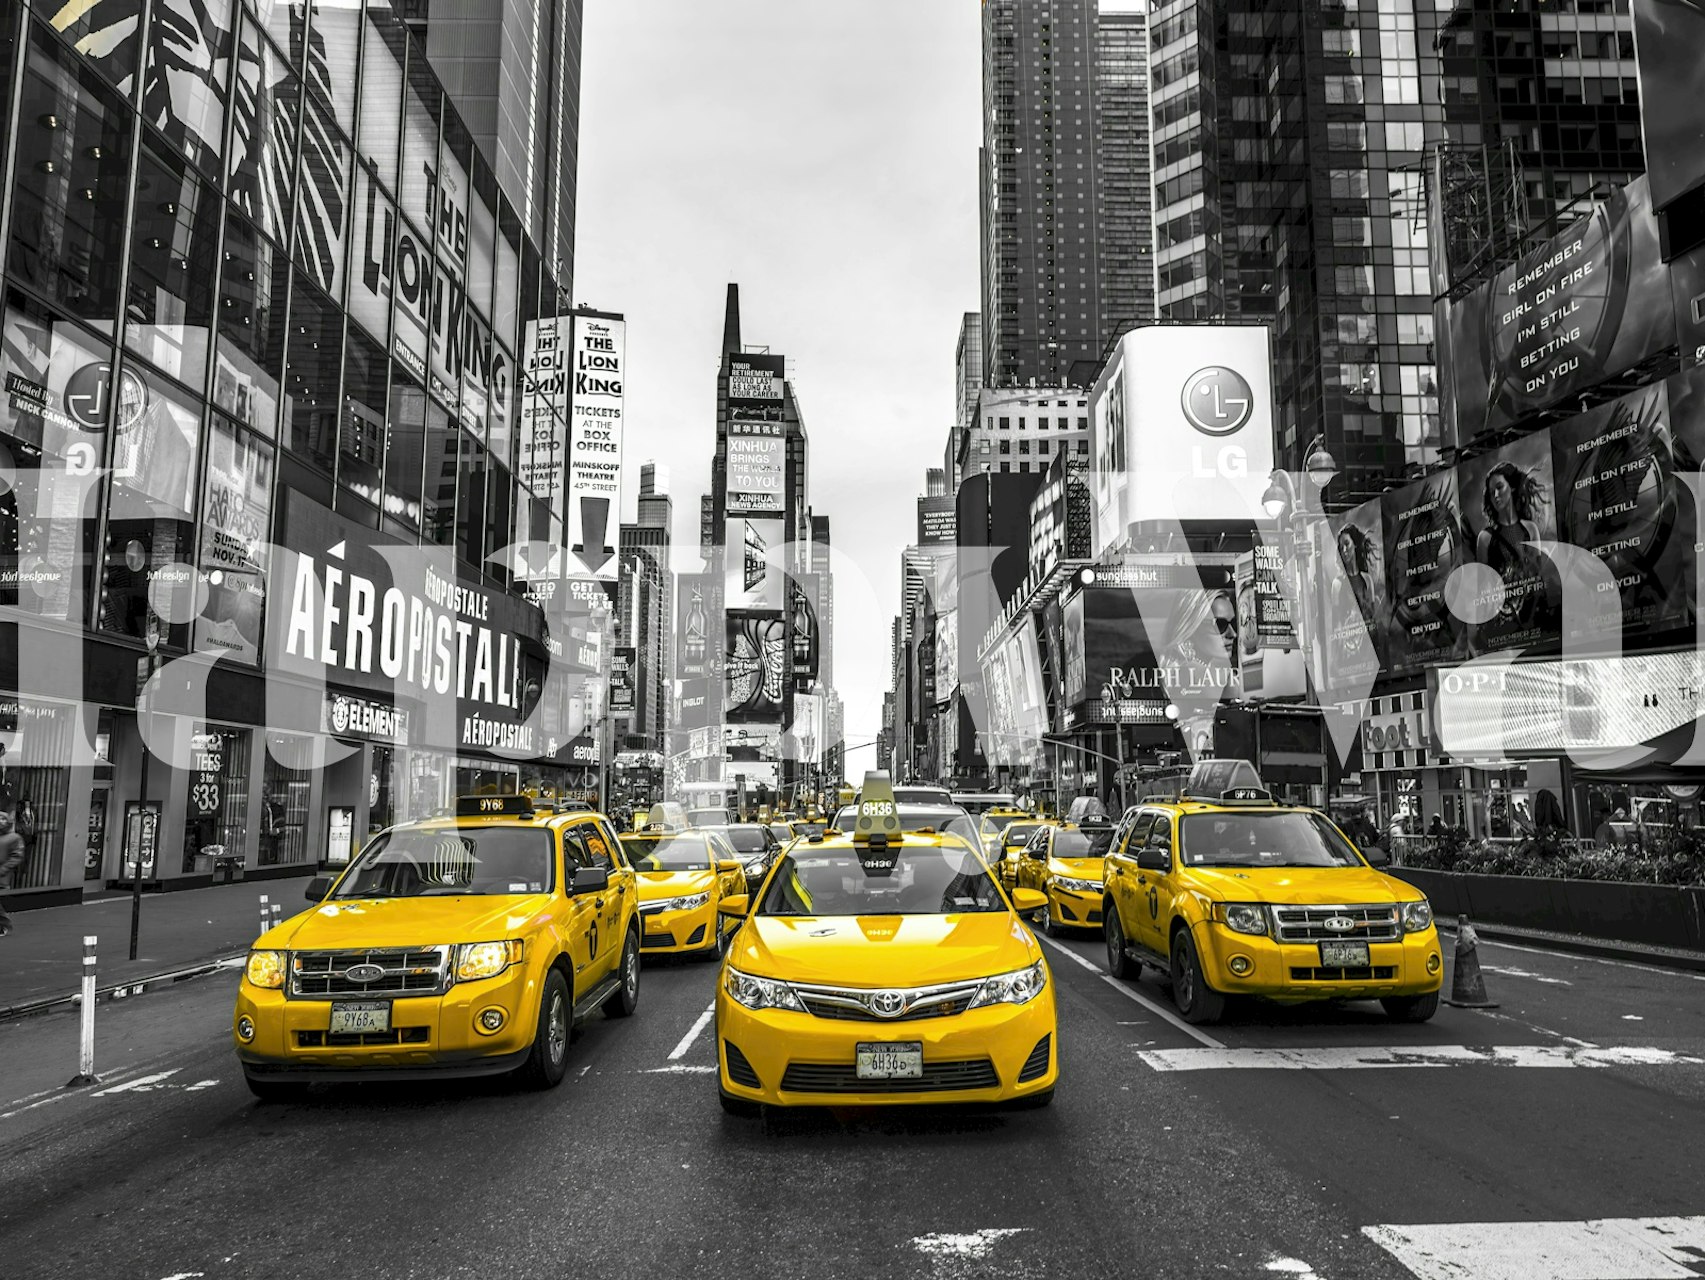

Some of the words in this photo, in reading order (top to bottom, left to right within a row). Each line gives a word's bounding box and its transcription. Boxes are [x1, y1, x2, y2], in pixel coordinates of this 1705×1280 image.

[423, 160, 465, 263] THE
[363, 156, 442, 338] LION
[1508, 240, 1582, 296] REMEMBER
[1502, 302, 1532, 325] GIRL
[1536, 285, 1556, 305] ON
[1561, 261, 1593, 290] FIRE
[1517, 325, 1536, 343] I'M
[1541, 301, 1580, 328] STILL
[446, 266, 505, 410] KING
[584, 336, 613, 350] THE
[1520, 327, 1581, 368] BETTING
[395, 338, 425, 376] ENTRANCE
[579, 350, 618, 371] LION
[731, 362, 751, 370] YOUR
[732, 377, 755, 385] COULD
[1526, 376, 1545, 392] ON
[1549, 356, 1579, 379] YOU
[12, 378, 42, 399] Hosted
[575, 372, 622, 395] KING
[16, 399, 40, 416] NICK
[41, 410, 80, 431] CANNON
[462, 405, 476, 427] STREET
[574, 405, 620, 419] TICKETS
[582, 420, 594, 428] AT
[596, 420, 612, 429] THE
[732, 424, 781, 435] 新华通讯社
[584, 430, 611, 440] BOX
[1576, 423, 1638, 454] REMEMBER
[576, 441, 617, 453] OFFICE
[730, 440, 777, 452] XINHUA
[572, 461, 620, 471] MINSKOFF
[730, 454, 770, 464] BRINGS
[1191, 444, 1248, 479] LG
[577, 471, 614, 481] THEATRE
[732, 464, 749, 473] THE
[1575, 472, 1598, 490] GIRL
[1601, 466, 1618, 481] ON
[1620, 459, 1646, 475] FIRE
[573, 482, 590, 490] 45TH
[592, 484, 618, 492] STREET
[736, 475, 752, 487] TO
[731, 501, 756, 509] NEWS
[738, 493, 774, 504] XINHUA
[1398, 500, 1440, 521] REMEMBER
[1588, 510, 1603, 521] I'M
[1605, 500, 1638, 517] STILL
[1397, 538, 1414, 551] GIRL
[1414, 534, 1425, 546] ON
[1427, 528, 1444, 542] FIRE
[1591, 536, 1641, 557] BETTING
[212, 547, 236, 563] NOV.
[1254, 545, 1279, 558] SOME
[1254, 558, 1284, 570] WALLS
[1406, 567, 1418, 577] I'M
[1418, 561, 1439, 575] STILL
[1095, 570, 1139, 584] sunglass
[1140, 570, 1157, 581] hut
[1255, 570, 1274, 582] CAN
[1597, 580, 1614, 593] ON
[1616, 574, 1641, 588] YOU
[425, 565, 488, 621] AÉROPOSTALE
[570, 582, 594, 592] GET
[1255, 582, 1278, 594] TALK
[572, 592, 609, 601] TICKETS
[1408, 590, 1441, 606] BETTING
[1473, 588, 1524, 606] CATCHING
[1411, 625, 1424, 635] ON
[1424, 621, 1440, 632] YOU
[611, 656, 627, 664] SOME
[611, 663, 629, 672] WALLS
[723, 662, 737, 671] give
[744, 662, 758, 670] back
[611, 678, 624, 687] TALK
[1110, 667, 1180, 688] RALPH
[350, 705, 401, 737] ELEMENT
[462, 711, 532, 751] AÉROPOSTALE
[195, 753, 222, 772] TEES
[200, 772, 207, 782] 3
[207, 772, 215, 782] for
[193, 784, 219, 810] $33
[1234, 789, 1257, 800] 6P76
[479, 799, 504, 812] 9Y68
[862, 801, 893, 816] 6H36
